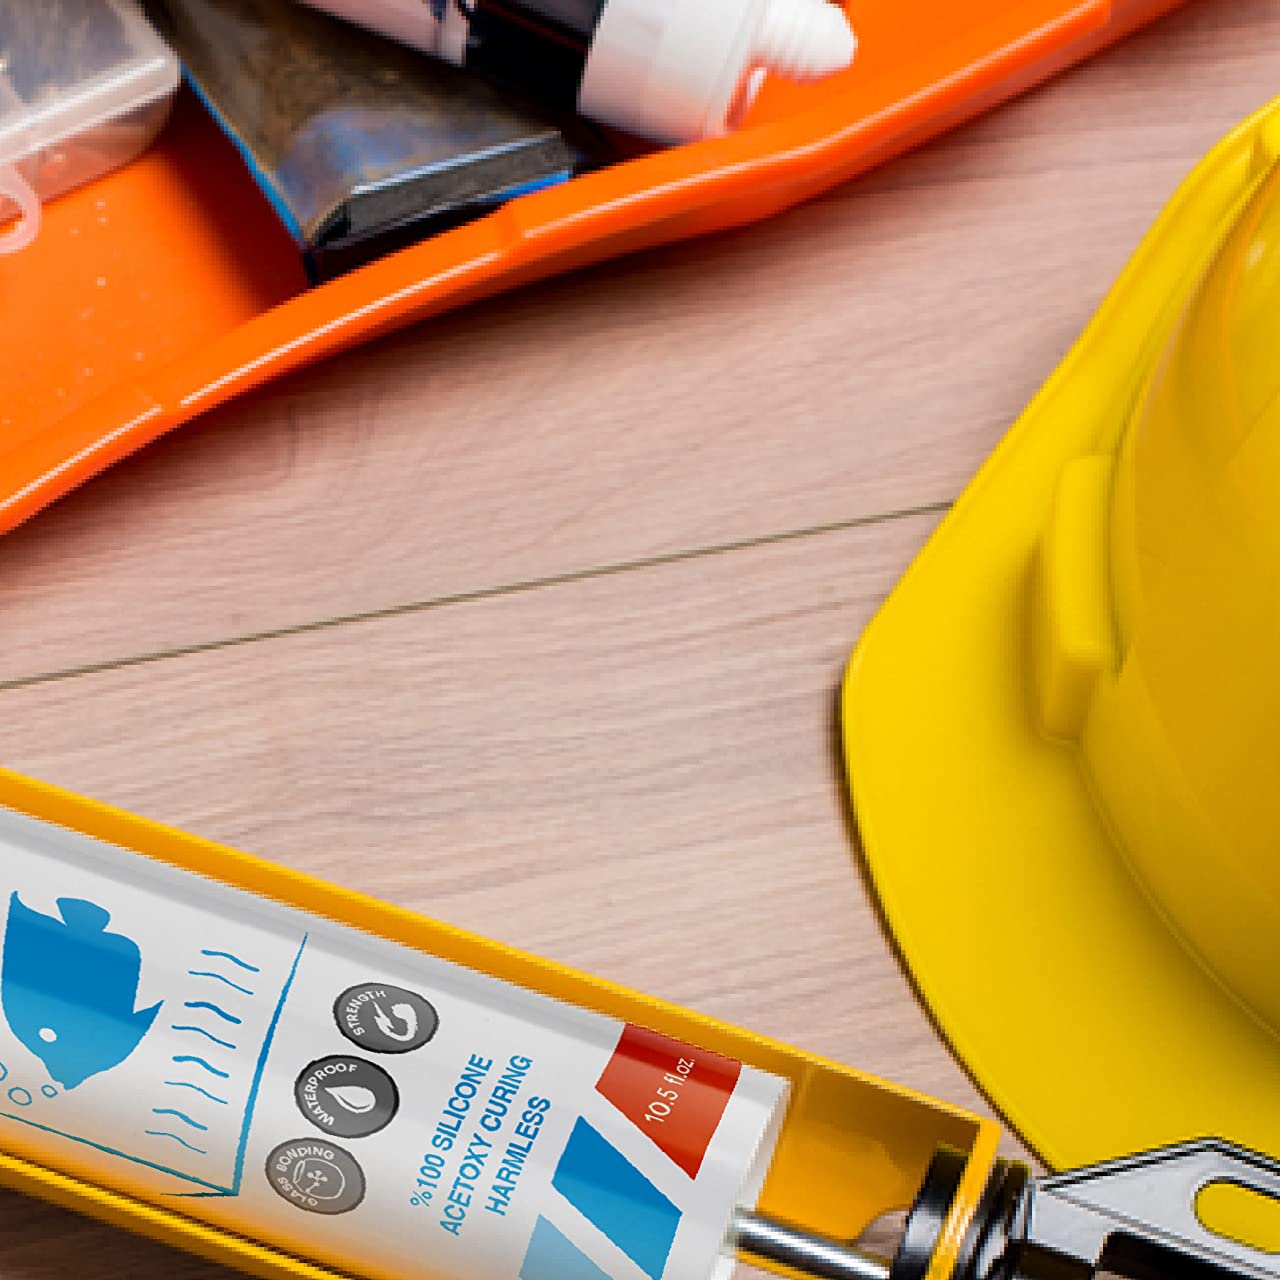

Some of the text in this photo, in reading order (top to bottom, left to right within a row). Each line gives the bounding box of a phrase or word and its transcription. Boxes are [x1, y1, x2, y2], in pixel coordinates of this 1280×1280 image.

[345, 990, 387, 1036] STRENGTH
[304, 1063, 358, 1126] WATERPROOF
[644, 1087, 678, 1123] 10.5
[410, 1053, 493, 1207] %100 SILICONE
[439, 1055, 533, 1236] ACETOXY CURING
[484, 1096, 551, 1216] HARMLESS
[276, 1146, 335, 1207] GLASS BONDING
